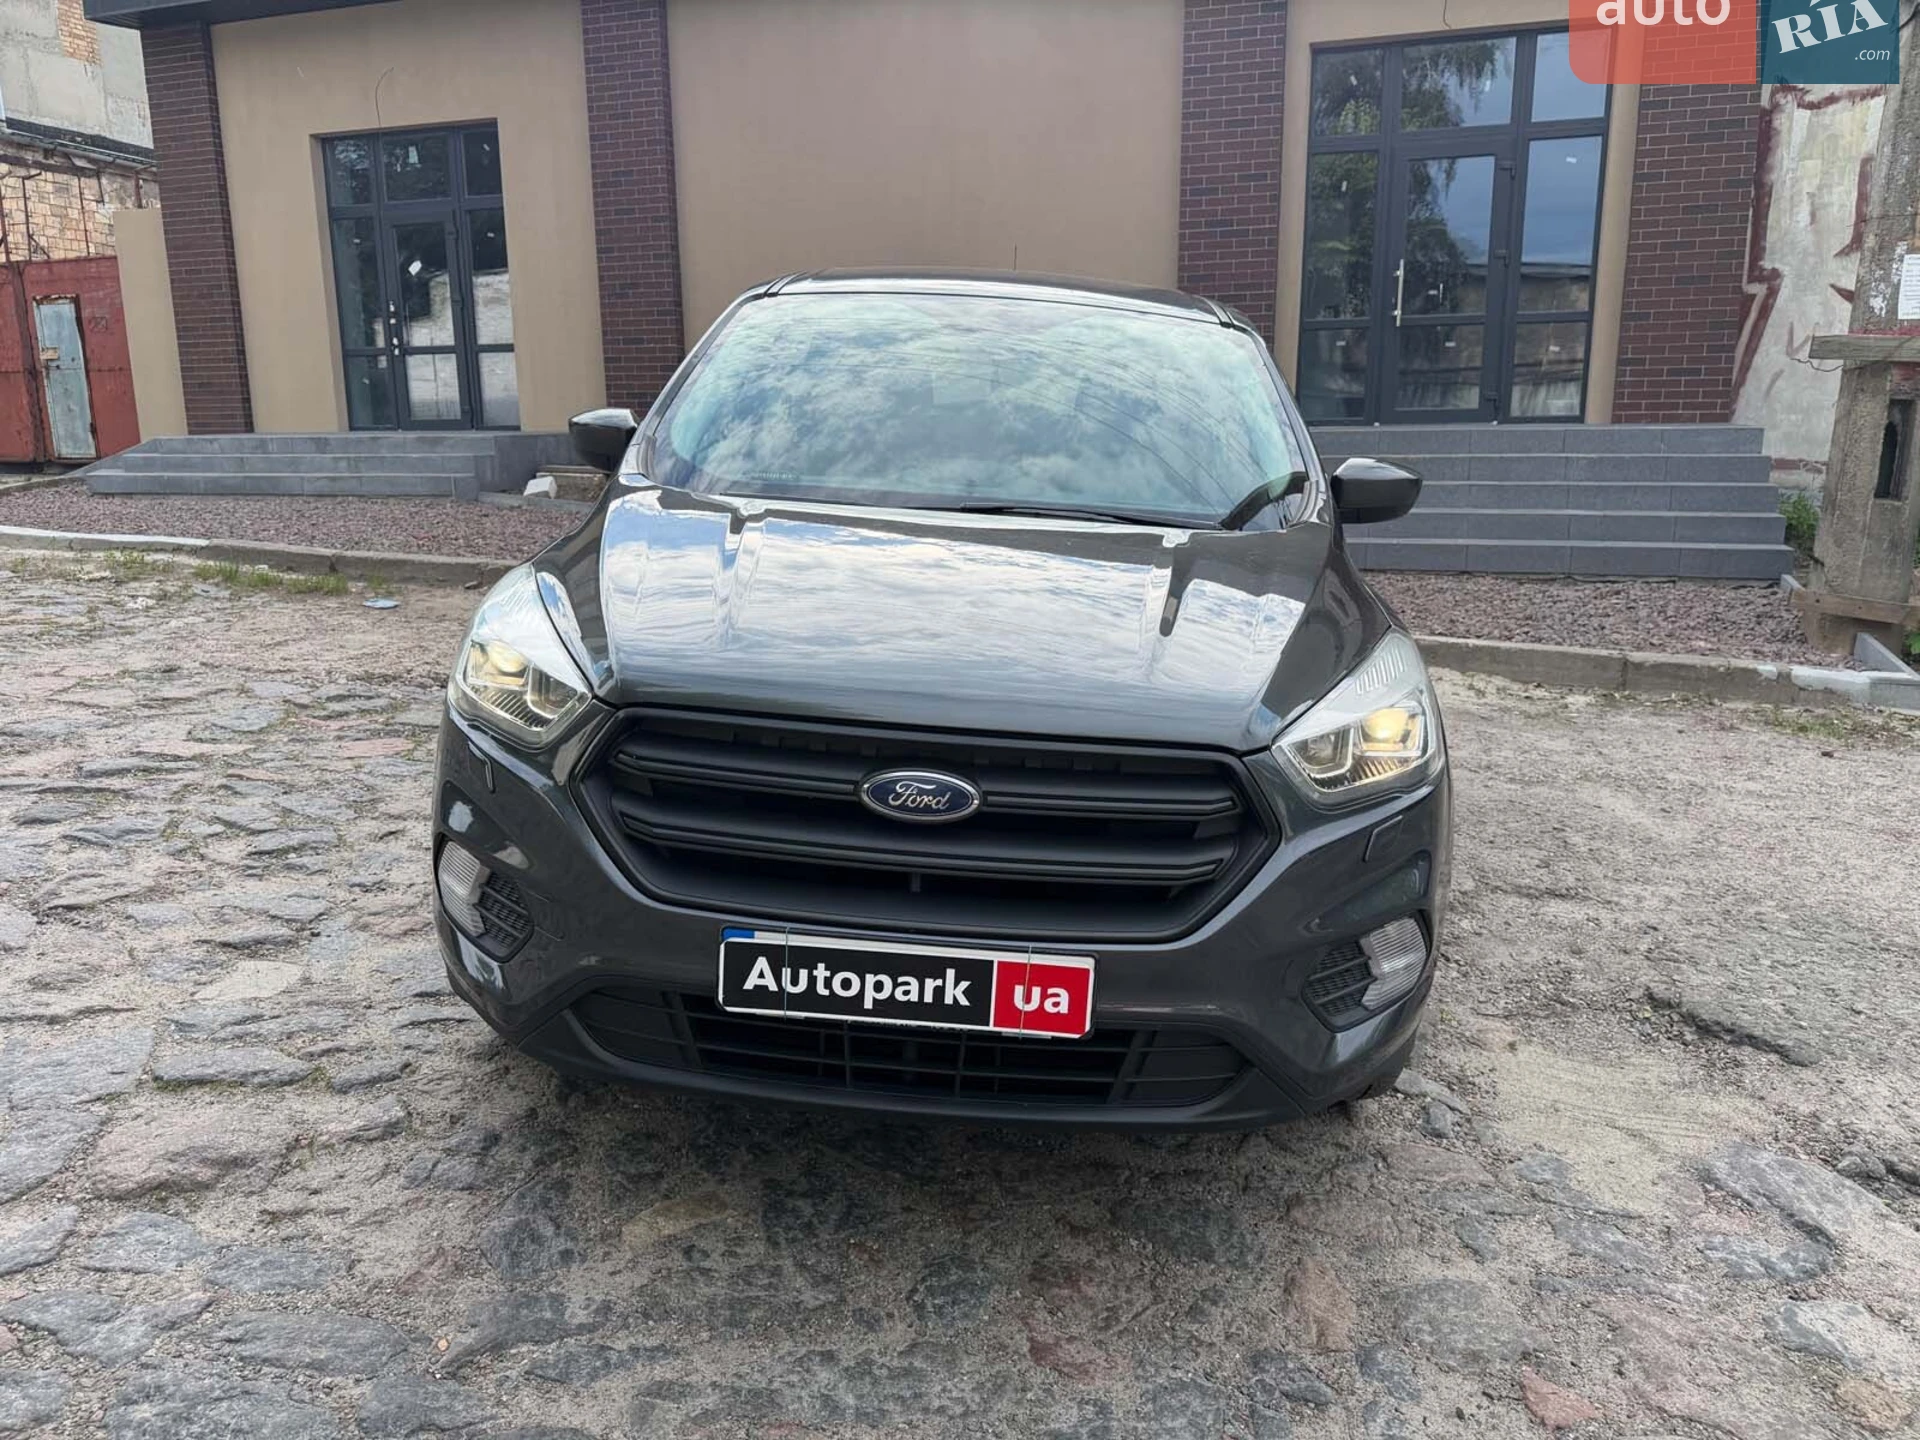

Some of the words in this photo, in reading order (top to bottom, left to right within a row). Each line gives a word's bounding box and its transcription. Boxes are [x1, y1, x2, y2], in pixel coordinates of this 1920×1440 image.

[887, 780, 951, 811] Ford
[743, 956, 971, 1009] Autopark
[1013, 984, 1070, 1014] ua
